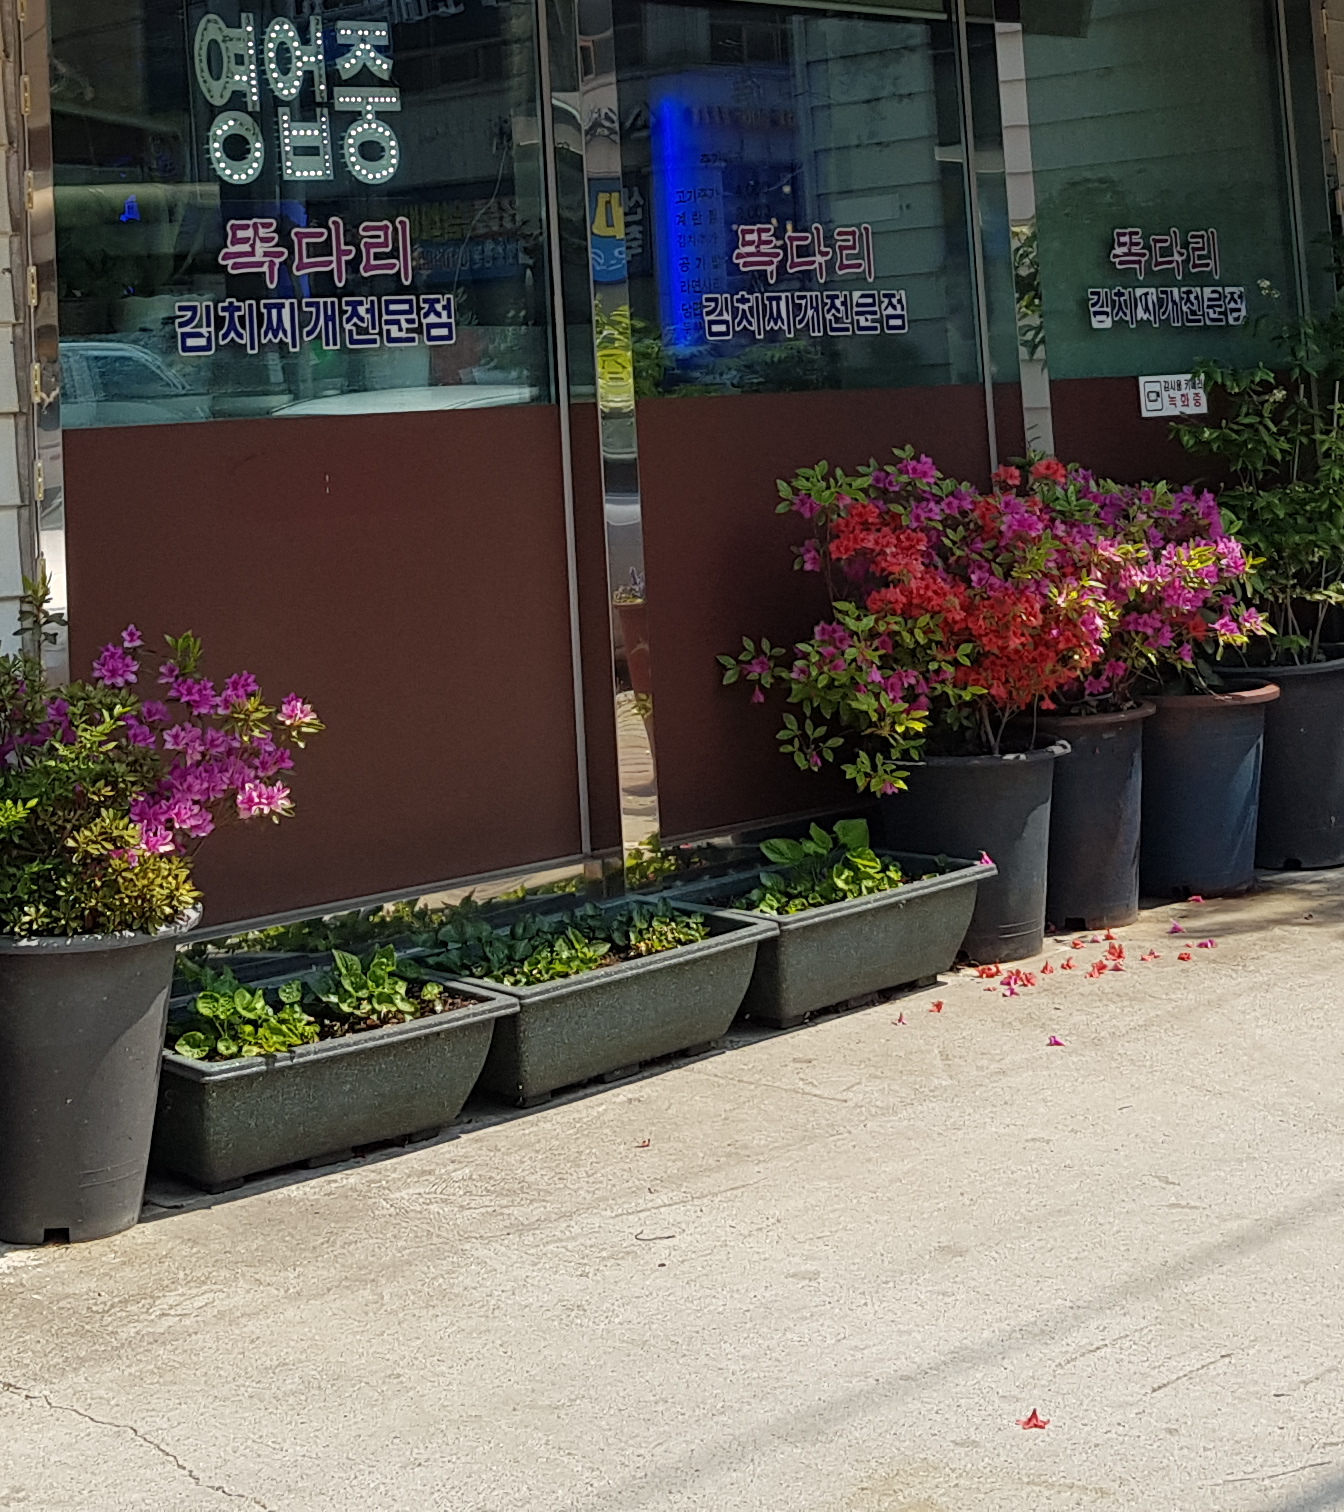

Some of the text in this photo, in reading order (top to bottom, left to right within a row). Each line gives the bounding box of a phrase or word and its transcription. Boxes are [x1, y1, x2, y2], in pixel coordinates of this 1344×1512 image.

[194, 13, 403, 185] 영업중
[218, 216, 413, 289] 똑다리
[732, 222, 875, 284] 똑다리
[1110, 227, 1220, 281] 똑다리
[175, 294, 457, 356] 김치찌개전문점
[703, 290, 908, 340] 김치찌개전문점
[1088, 286, 1246, 329] 김치찌개전문점
